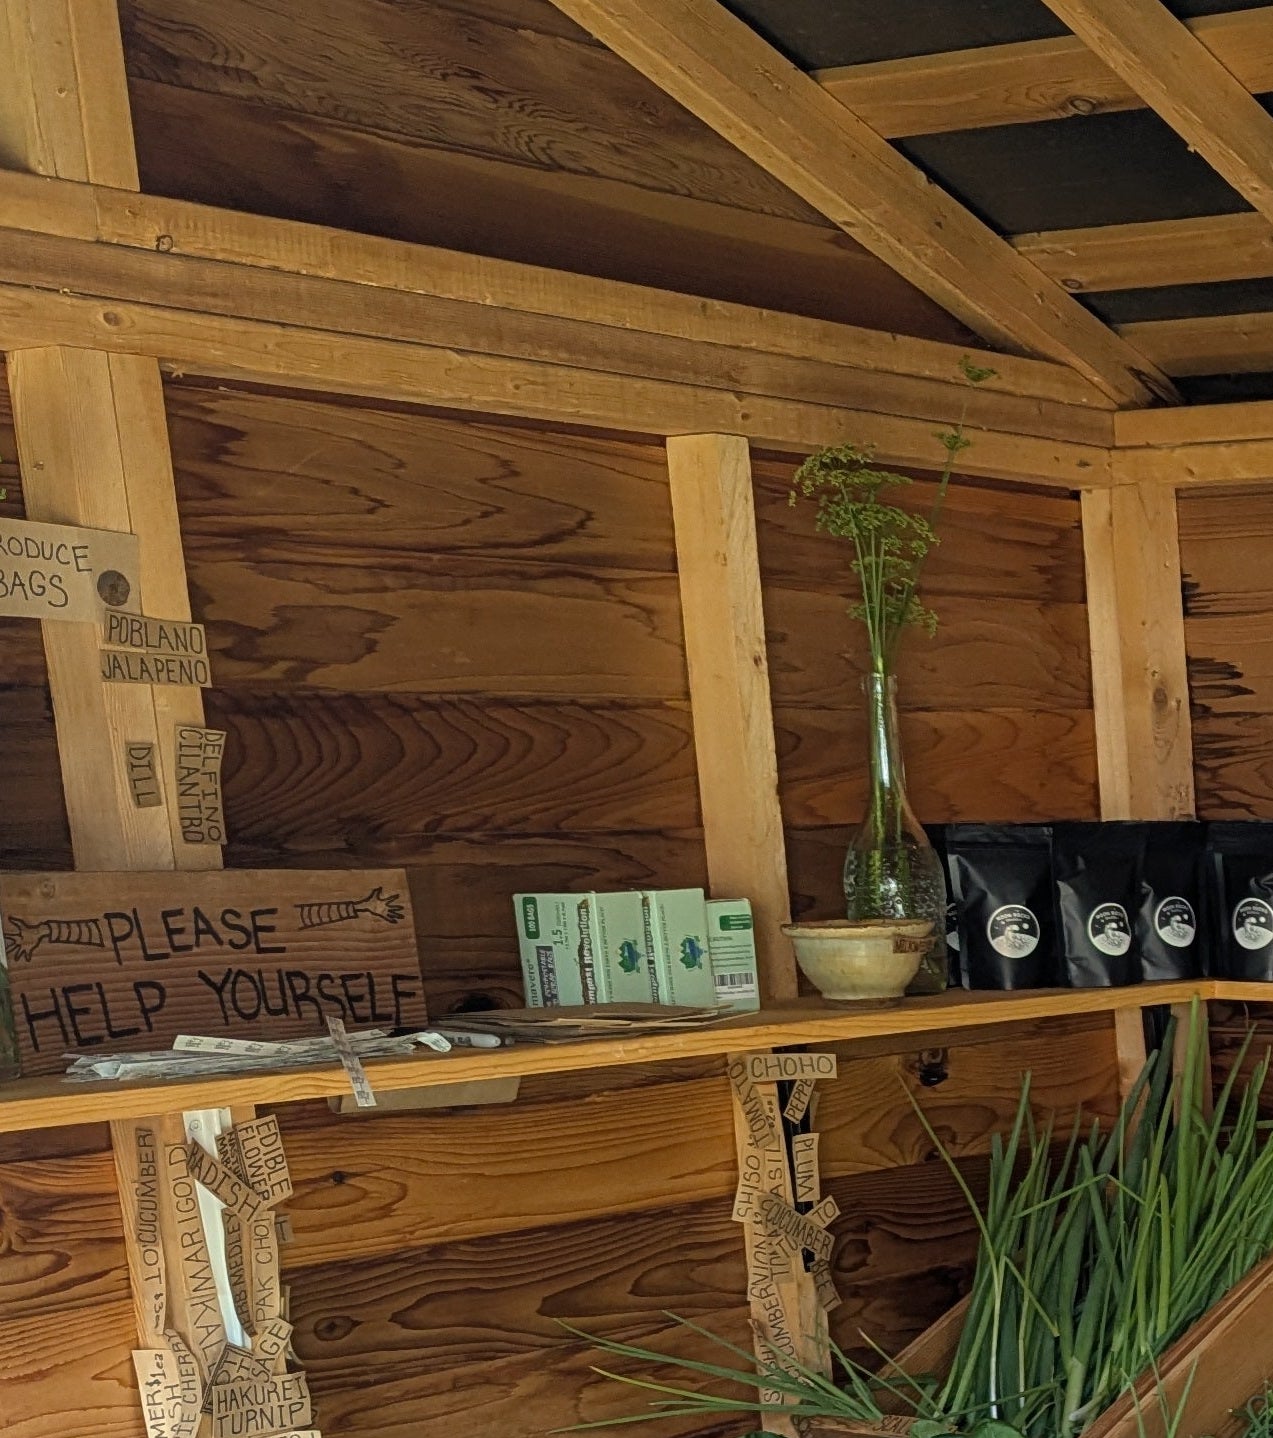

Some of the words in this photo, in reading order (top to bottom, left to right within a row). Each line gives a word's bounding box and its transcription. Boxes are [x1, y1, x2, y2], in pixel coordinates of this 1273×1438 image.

[108, 615, 204, 654] POBLANO
[102, 653, 208, 685] JALAPENO
[127, 746, 153, 805] DILL
[177, 726, 204, 843] CILANTRO
[201, 731, 224, 842] DELFINO
[104, 906, 286, 966] PLEASE
[20, 980, 166, 1053] HELP
[198, 967, 419, 1026] YOURSELF
[187, 1144, 261, 1222] RADISH
[256, 1119, 291, 1198] EDIBLE
[737, 1155, 761, 1218] SHISO
[794, 1136, 814, 1198] PLUM
[167, 1146, 215, 1293] MARIGOLD
[226, 1211, 247, 1286] MEDLEY
[253, 1217, 273, 1265] CHOI
[255, 1275, 274, 1323] PAK
[812, 1258, 839, 1308] BEET
[158, 1329, 199, 1405] CHERRY
[250, 1322, 291, 1384] SAGE
[216, 1401, 305, 1437] TURNIP
[217, 1377, 307, 1413] HAKUREI
